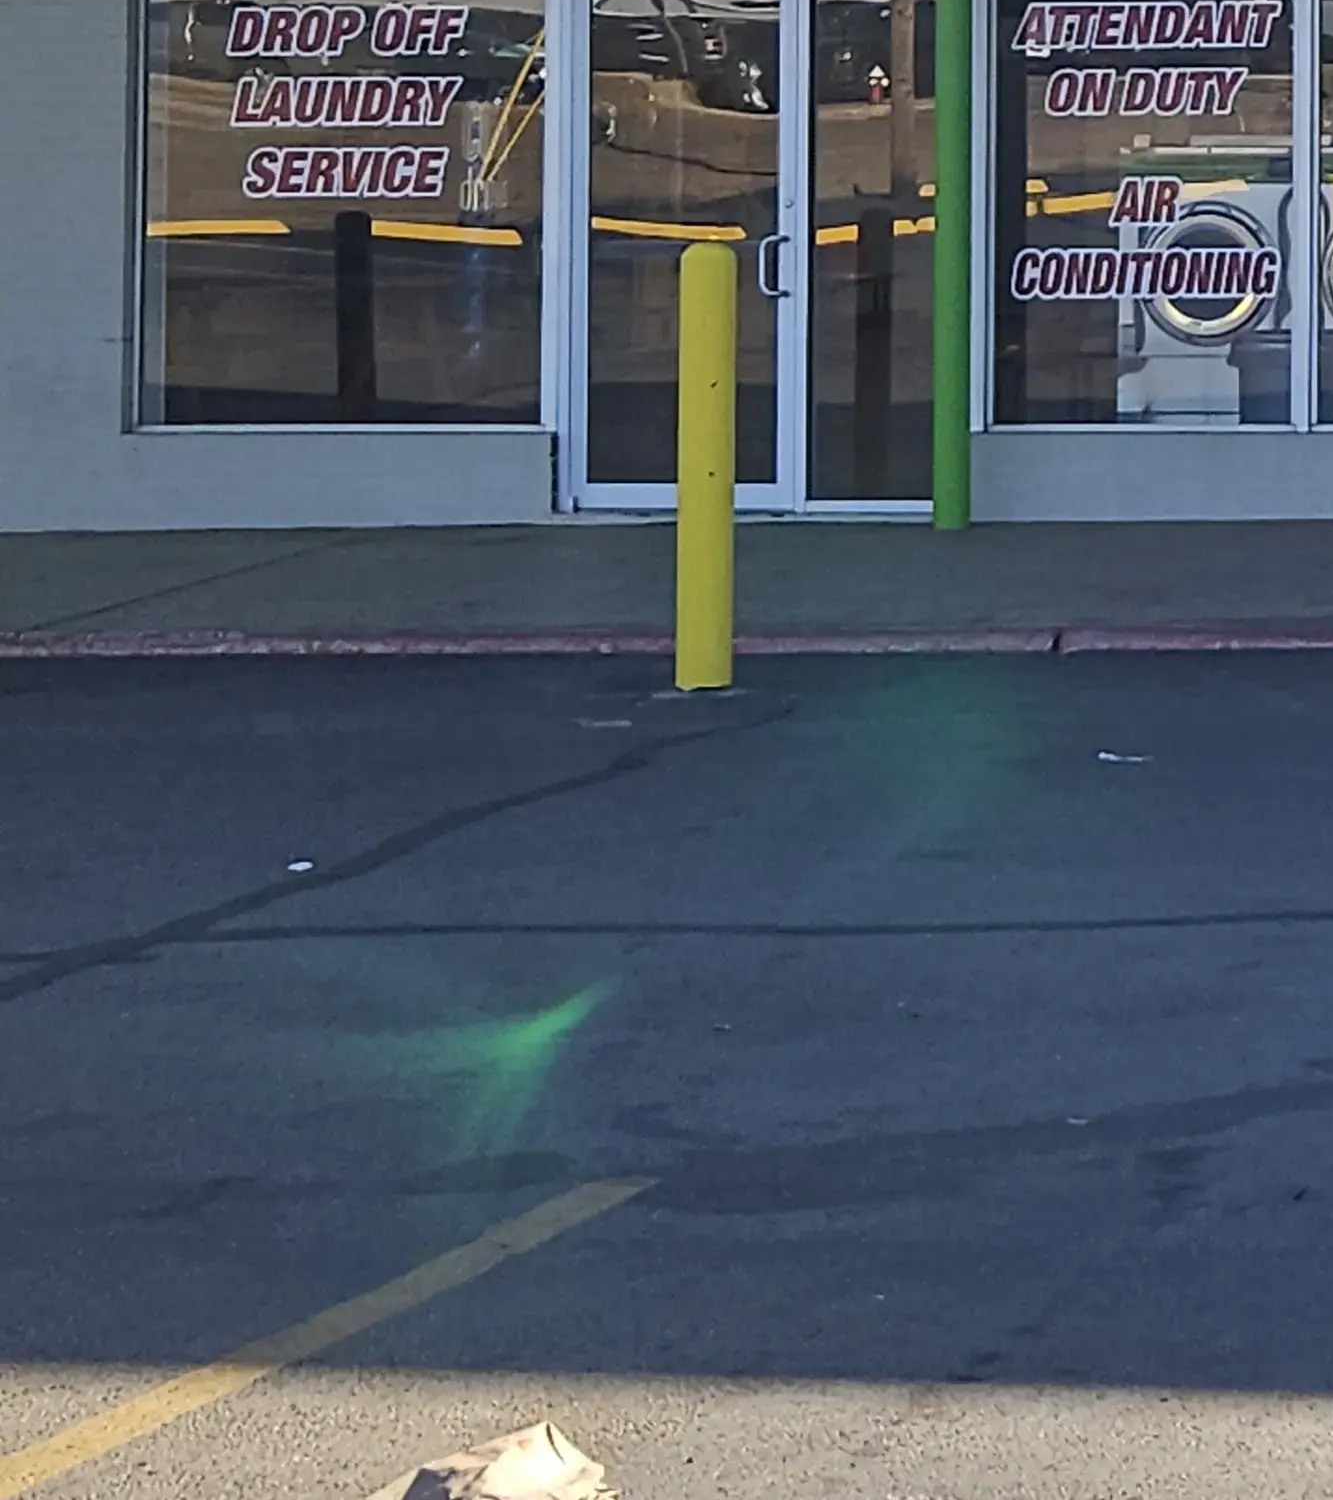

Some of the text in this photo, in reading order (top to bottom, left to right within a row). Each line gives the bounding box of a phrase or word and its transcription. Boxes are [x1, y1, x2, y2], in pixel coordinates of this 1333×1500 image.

[226, 4, 468, 56] DROP OFF
[1012, 0, 1282, 52] ATTENDANT
[229, 75, 464, 128] LAUNDRY
[1045, 67, 1249, 117] ON DUTY
[242, 145, 450, 198] SERVICE
[1109, 175, 1183, 227] AIR
[1011, 247, 1282, 301] CONDITIONING
